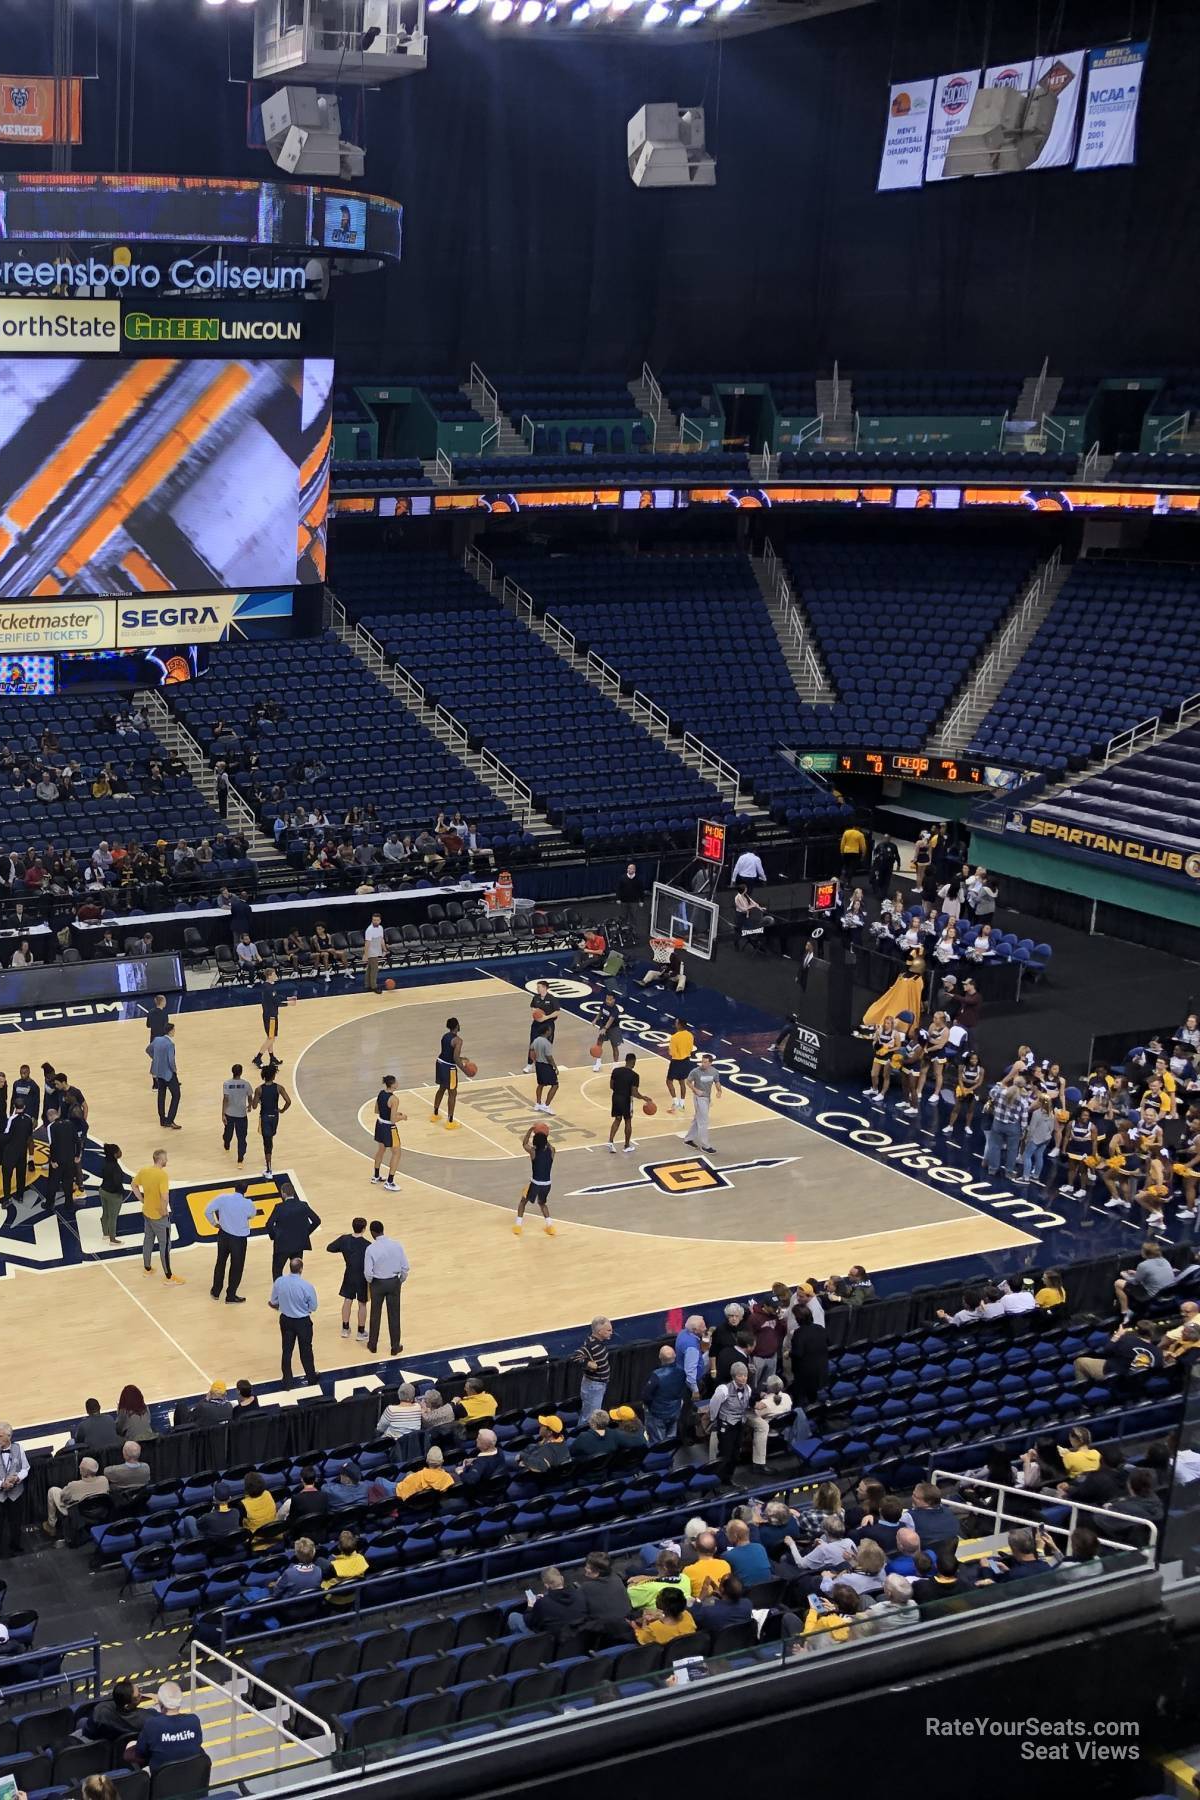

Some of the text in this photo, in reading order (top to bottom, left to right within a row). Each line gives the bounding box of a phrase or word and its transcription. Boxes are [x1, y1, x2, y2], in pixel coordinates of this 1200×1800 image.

[1093, 54, 1142, 67] BASKETBALL
[1090, 88, 1125, 103] NCAA
[897, 126, 917, 135] MEN'S
[1088, 131, 1105, 140] 2001
[887, 136, 923, 146] BASKETBALL
[887, 146, 922, 156] CHAMPIONS
[169, 258, 306, 289] Coliseum
[124, 311, 301, 341] GREEN LINCOLN
[121, 606, 219, 628] SEGRA
[43, 630, 88, 642] TICKETS
[842, 760, 850, 769] 4
[875, 762, 883, 773] 0
[896, 756, 928, 771] 14:06
[948, 769, 957, 780] 0
[971, 772, 979, 781] 4
[704, 824, 724, 839] 14:06
[704, 836, 721, 859] 30
[1030, 818, 1183, 871] SPARTAN CLUB
[741, 926, 765, 937] SPALDING
[797, 1027, 821, 1048] TFA
[793, 1047, 818, 1063] FINANCIAL
[800, 1043, 815, 1054] TRIAD
[793, 1055, 817, 1070] ADVISORS
[579, 1000, 1067, 1229] Greesboro Coliseum
[161, 1731, 195, 1742] MetLife
